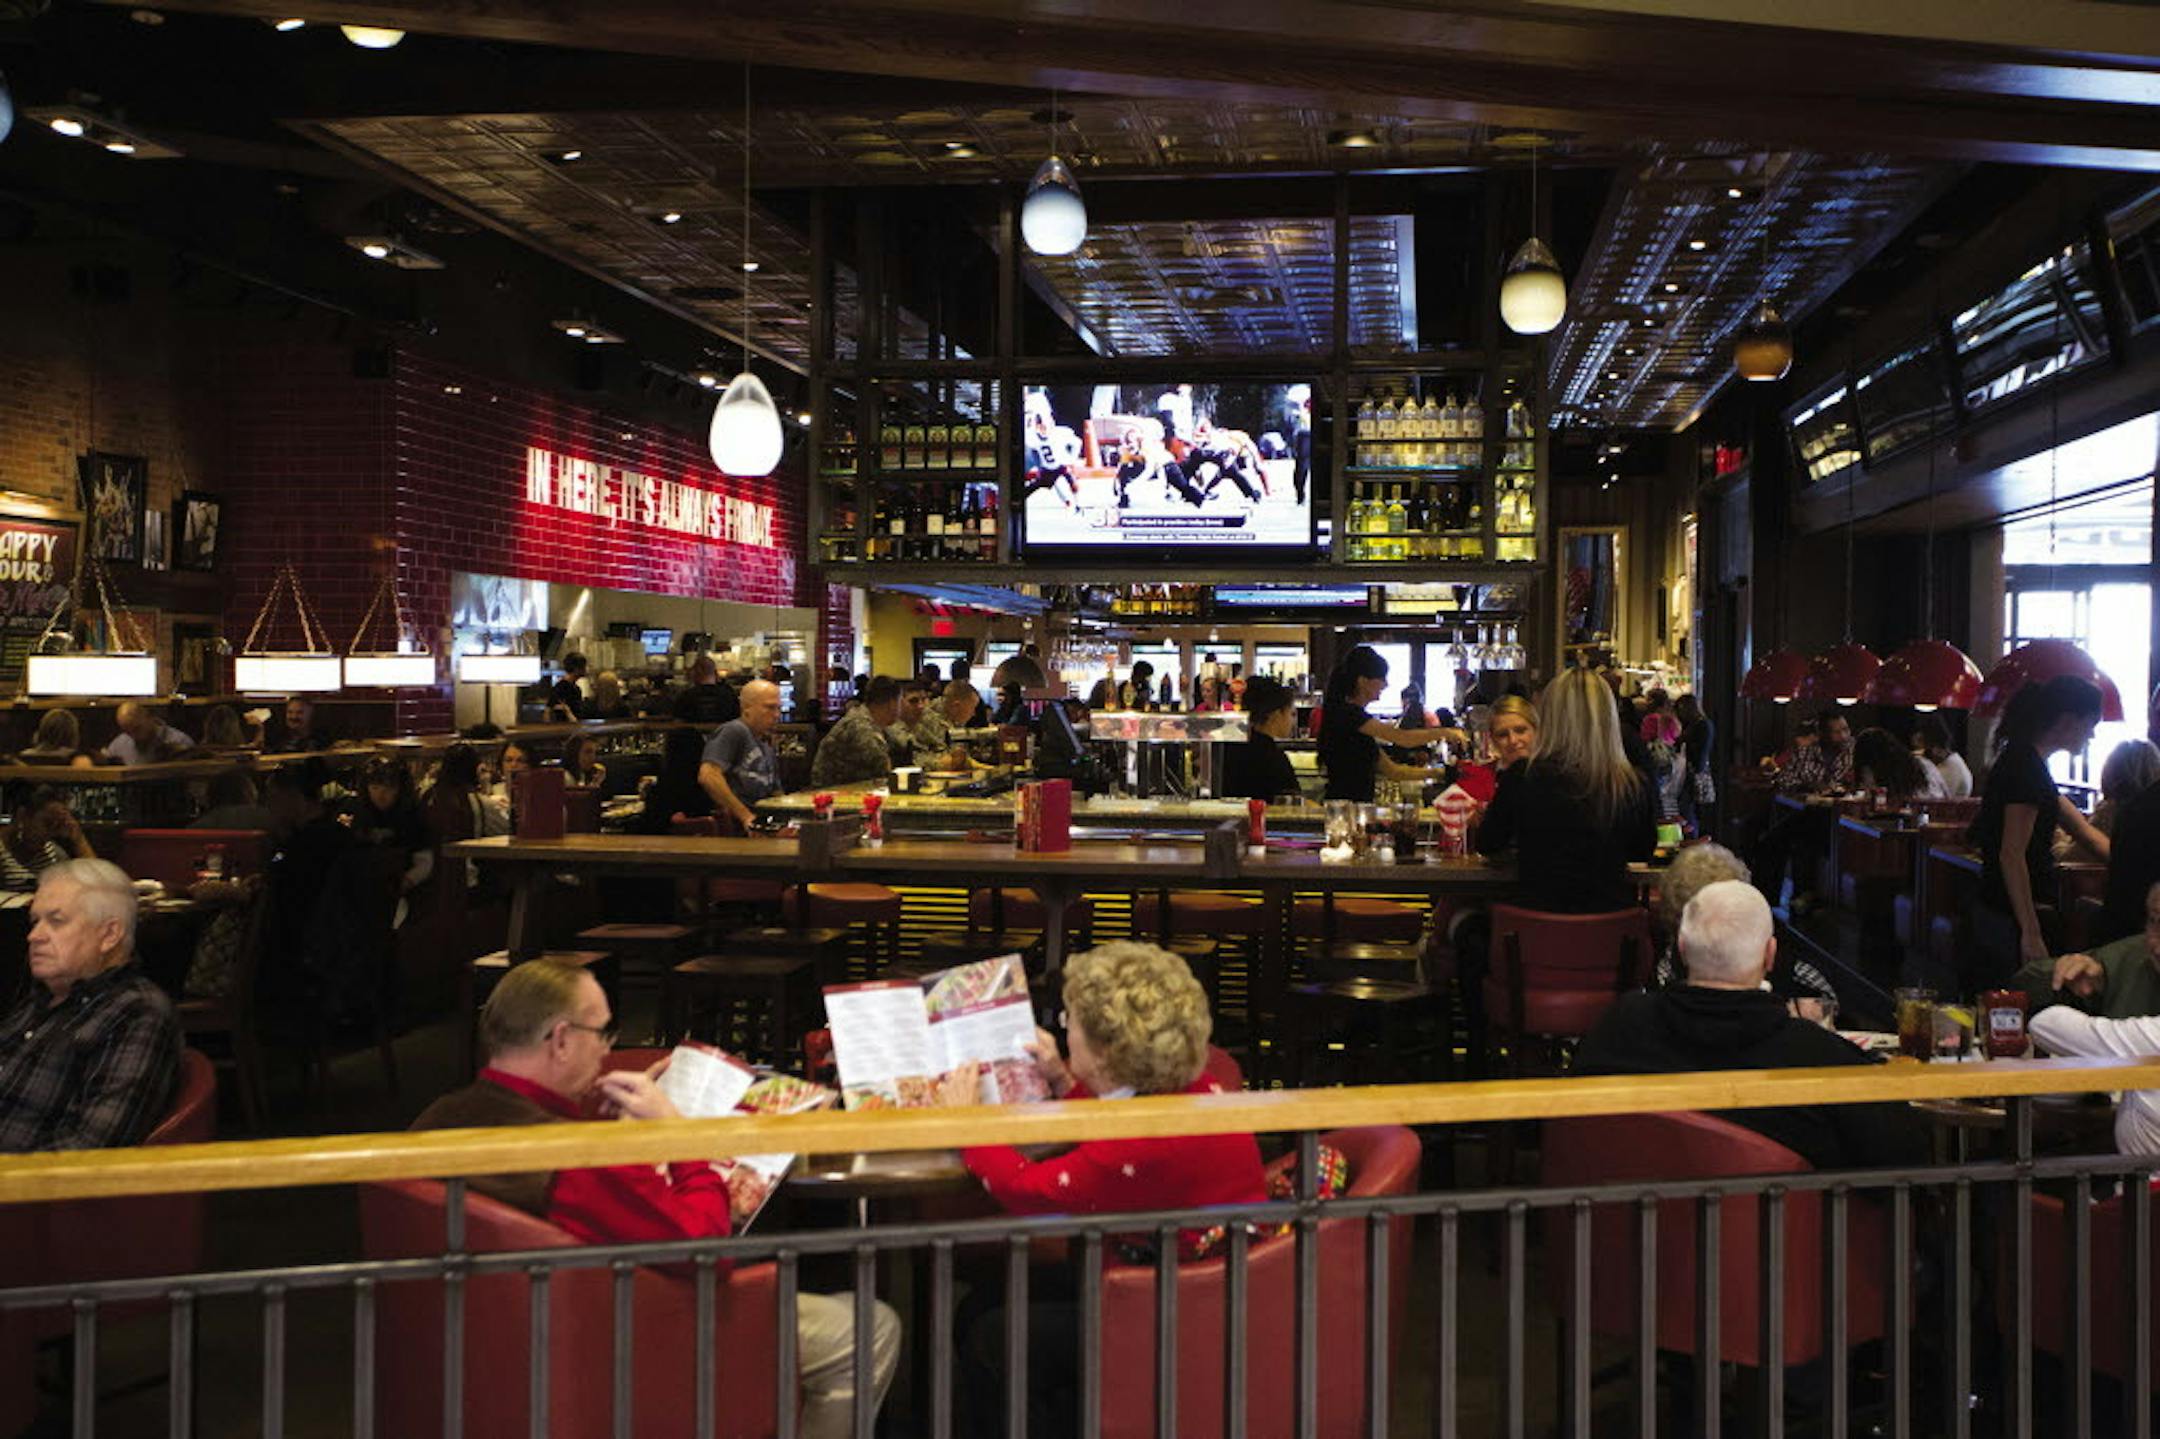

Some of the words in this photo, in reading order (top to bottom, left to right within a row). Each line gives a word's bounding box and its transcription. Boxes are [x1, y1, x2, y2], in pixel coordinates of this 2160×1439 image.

[527, 446, 551, 505] IN
[557, 454, 617, 529] HERE,
[621, 470, 656, 526] IT'S
[658, 479, 722, 539] ALWAYS
[0, 530, 58, 562] APPY
[0, 560, 42, 584] OUR
